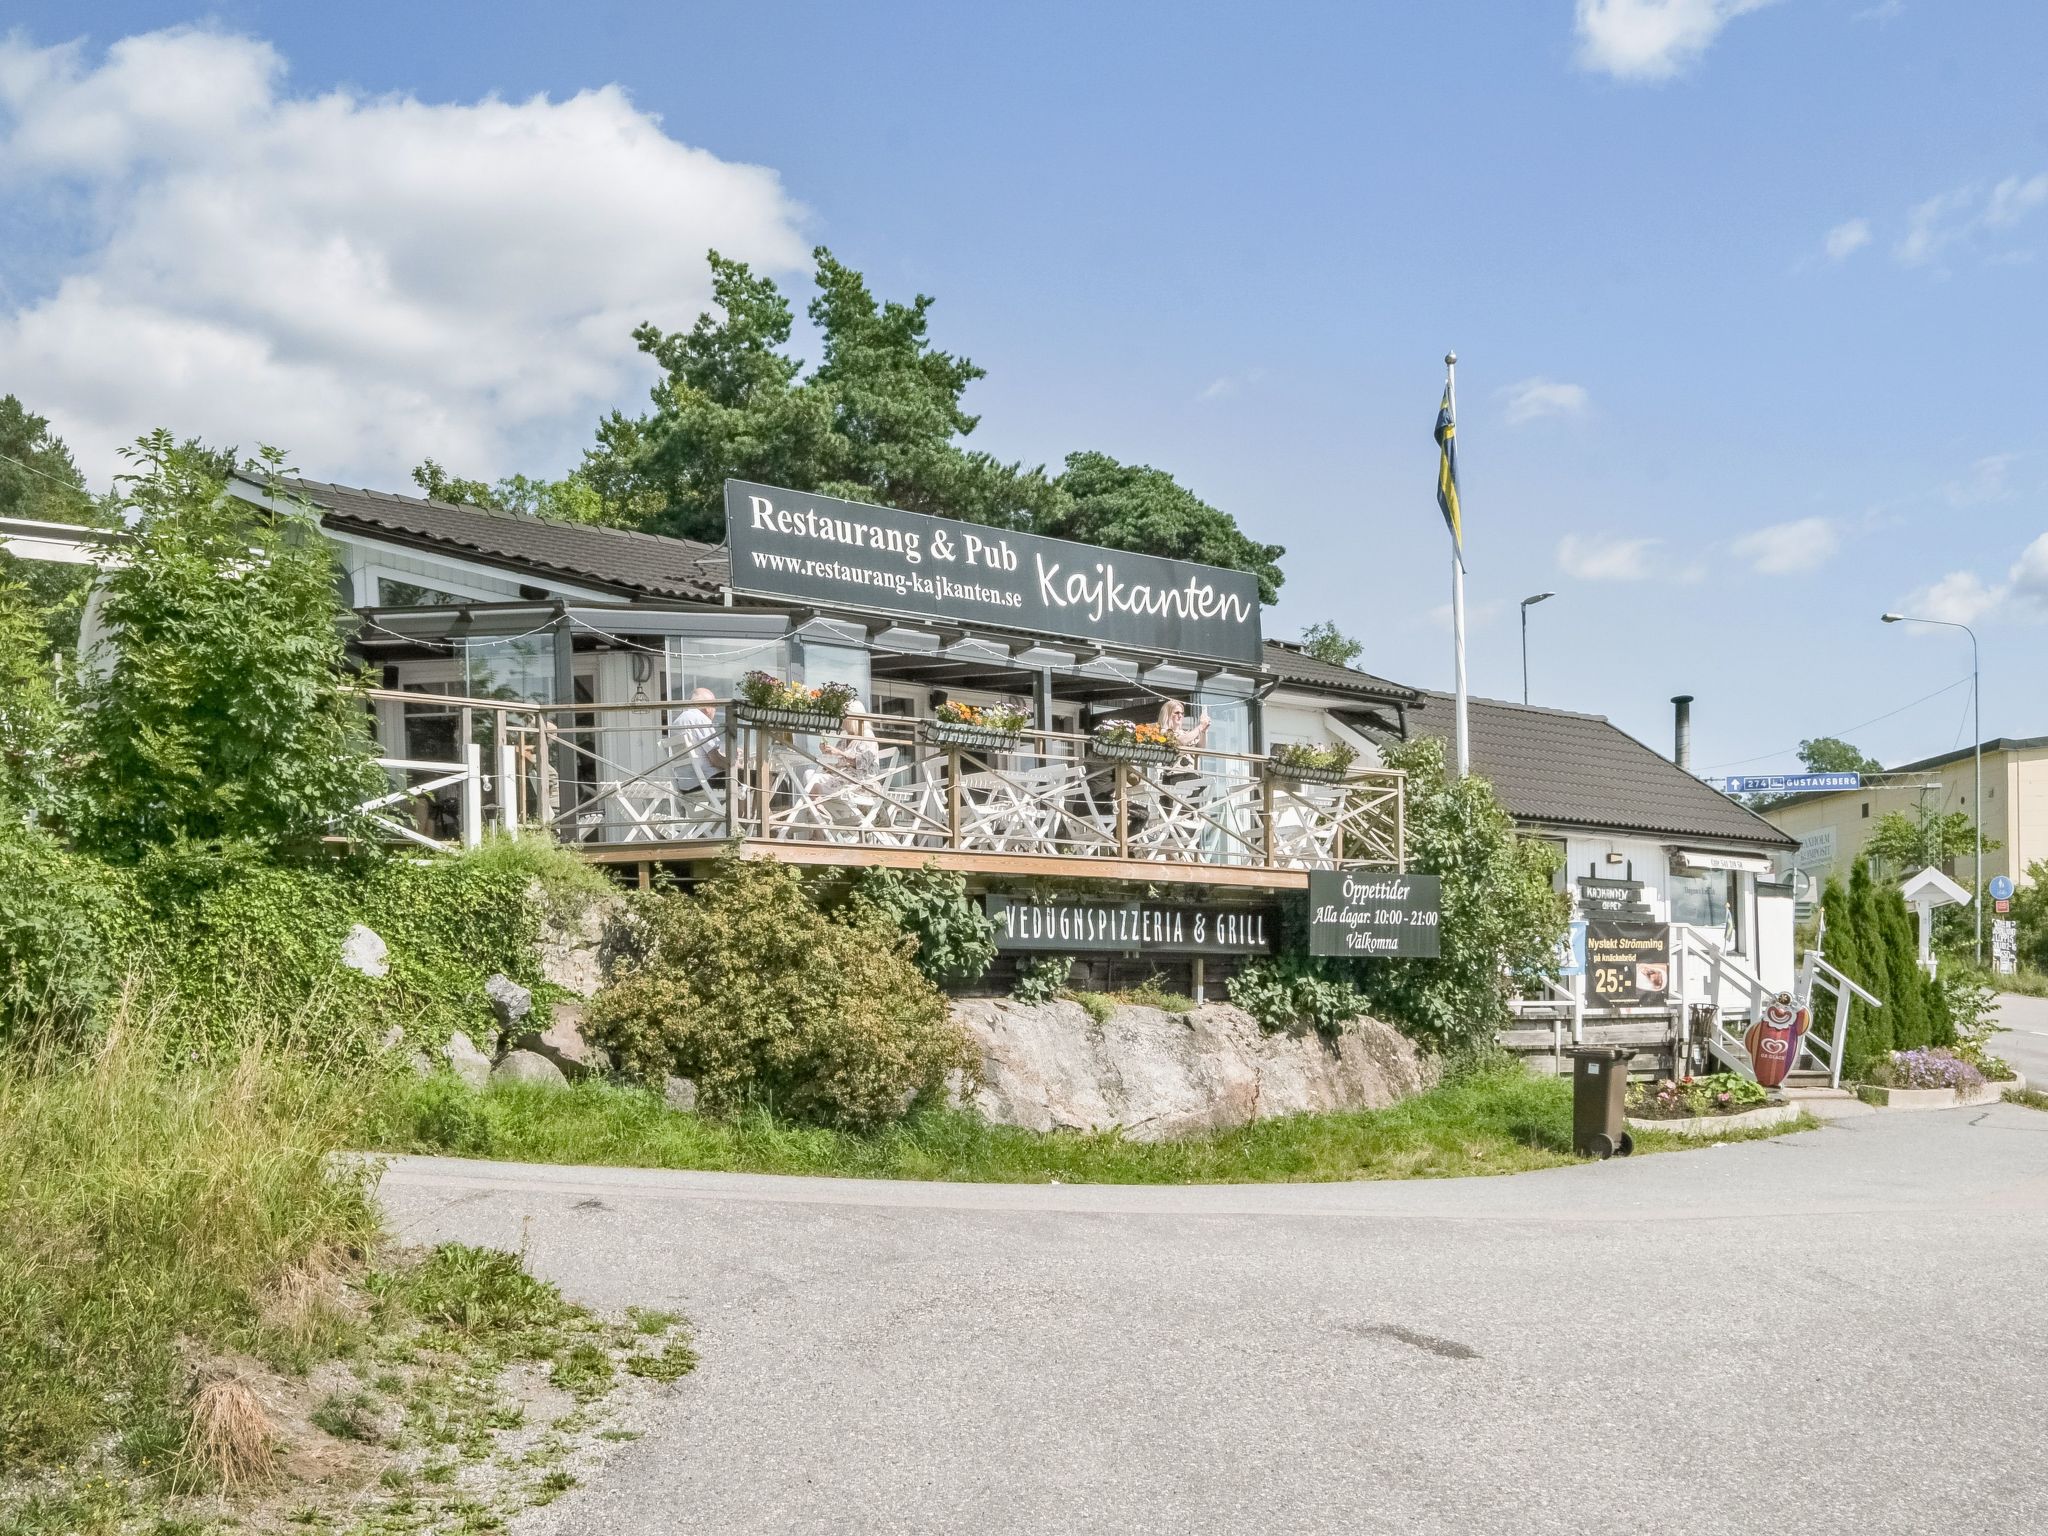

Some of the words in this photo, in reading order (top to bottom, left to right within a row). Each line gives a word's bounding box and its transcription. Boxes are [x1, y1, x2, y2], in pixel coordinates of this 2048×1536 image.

[749, 495, 921, 564] Restaurang
[930, 529, 956, 562] &
[963, 534, 1018, 571] Pub
[751, 551, 1022, 608] www.restaurang-kajkanten.se
[1036, 552, 1251, 623] Kajkanten
[1747, 780, 1767, 788] 274
[1787, 777, 1857, 787] GUSTAVSBERG
[1342, 874, 1411, 905] Öppettider
[1194, 913, 1206, 944] &
[1216, 914, 1266, 945] GRILL
[1312, 905, 1337, 925] Alla
[1374, 909, 1403, 925] 10:00
[1410, 910, 1438, 926] 21:00
[1346, 932, 1399, 953] Välkomna
[1618, 938, 1663, 950] Strömming
[1595, 968, 1632, 993] 25:-
